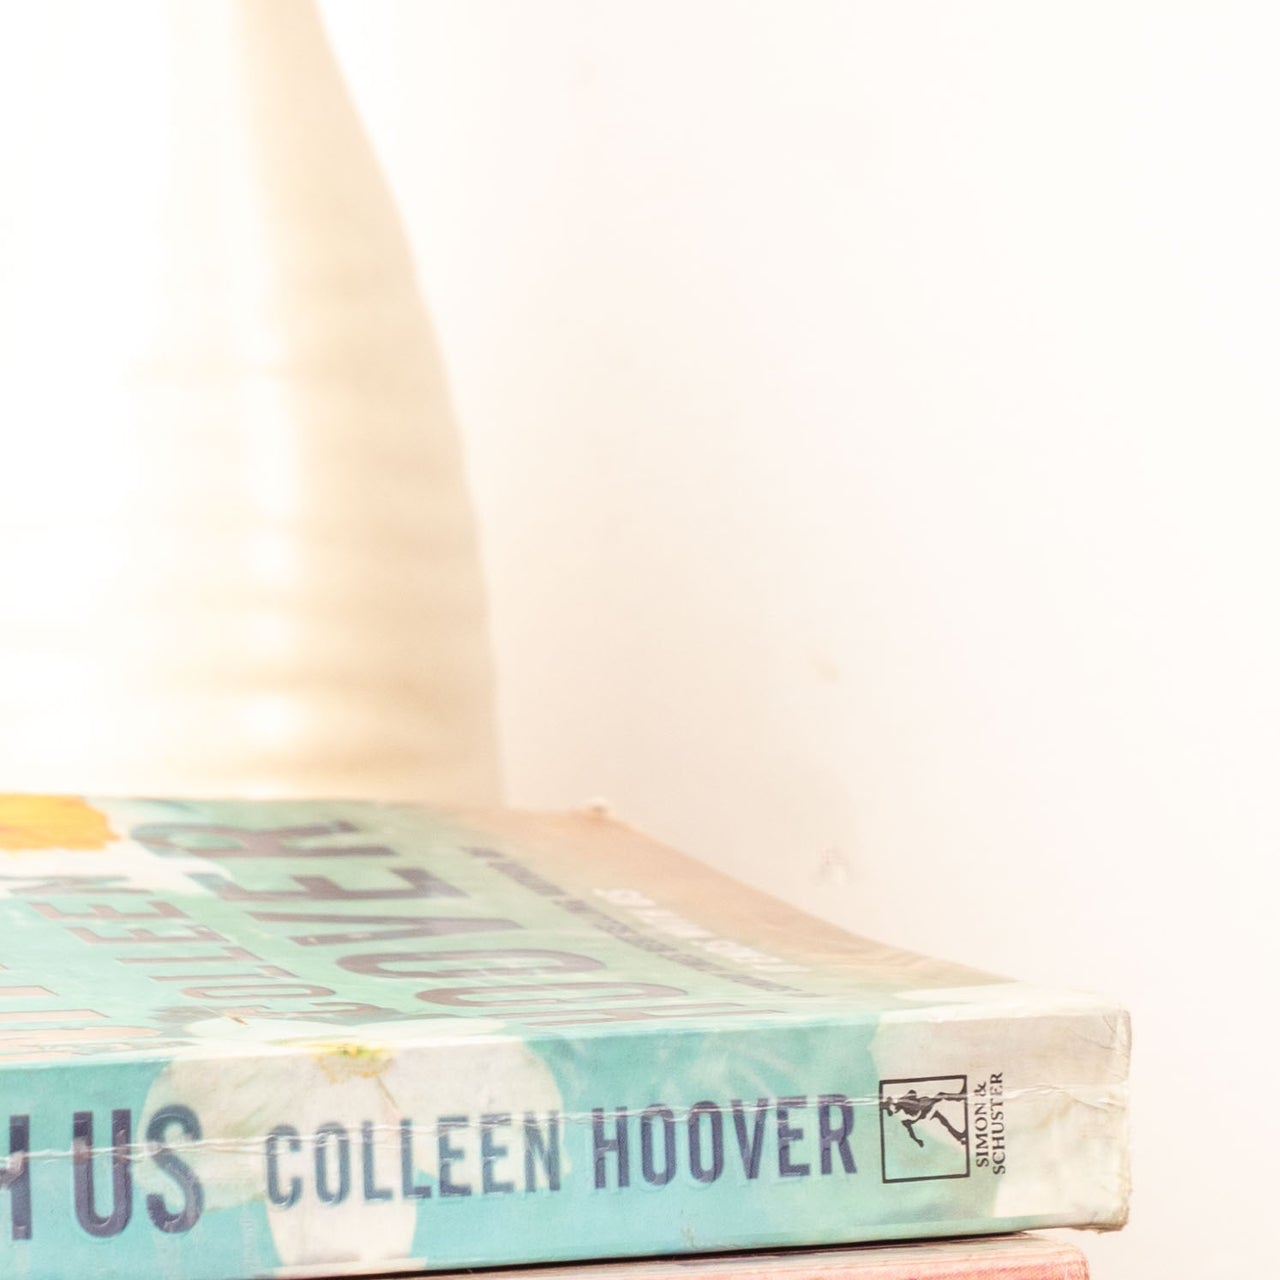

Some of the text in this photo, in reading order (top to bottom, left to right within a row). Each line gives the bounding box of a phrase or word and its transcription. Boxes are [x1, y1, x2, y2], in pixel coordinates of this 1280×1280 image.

[130, 819, 787, 1027] HOOVER
[72, 1103, 204, 1239] US
[264, 1106, 563, 1209] COLLEEN
[592, 1094, 859, 1190] HOOVER
[973, 1081, 989, 1168] SIMON &
[989, 1072, 1006, 1175] SCHUSTER
